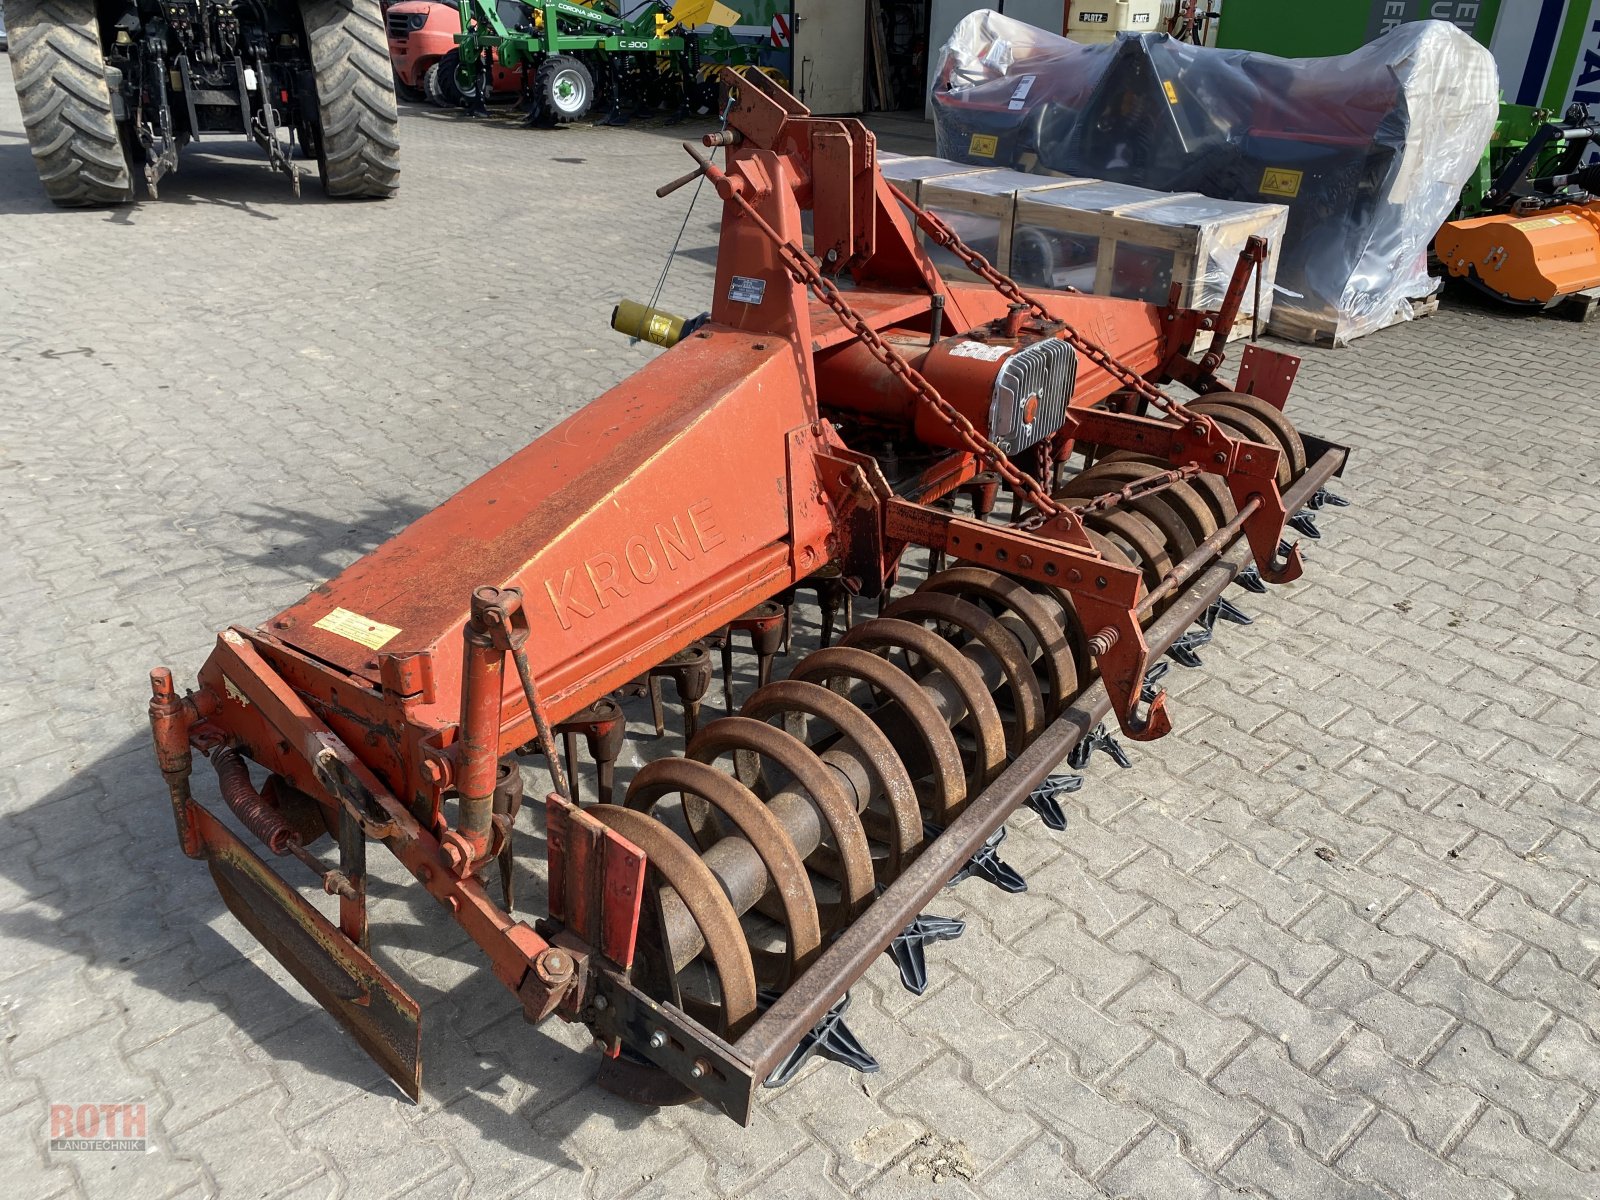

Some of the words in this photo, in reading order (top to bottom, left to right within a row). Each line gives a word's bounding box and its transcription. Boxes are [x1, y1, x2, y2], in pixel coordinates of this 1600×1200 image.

[558, 2, 586, 15] CORONA
[587, 11, 602, 20] 300
[1083, 13, 1103, 22] PLATZ
[620, 40, 627, 48] C
[628, 41, 648, 49] 300
[543, 498, 727, 631] KRONE
